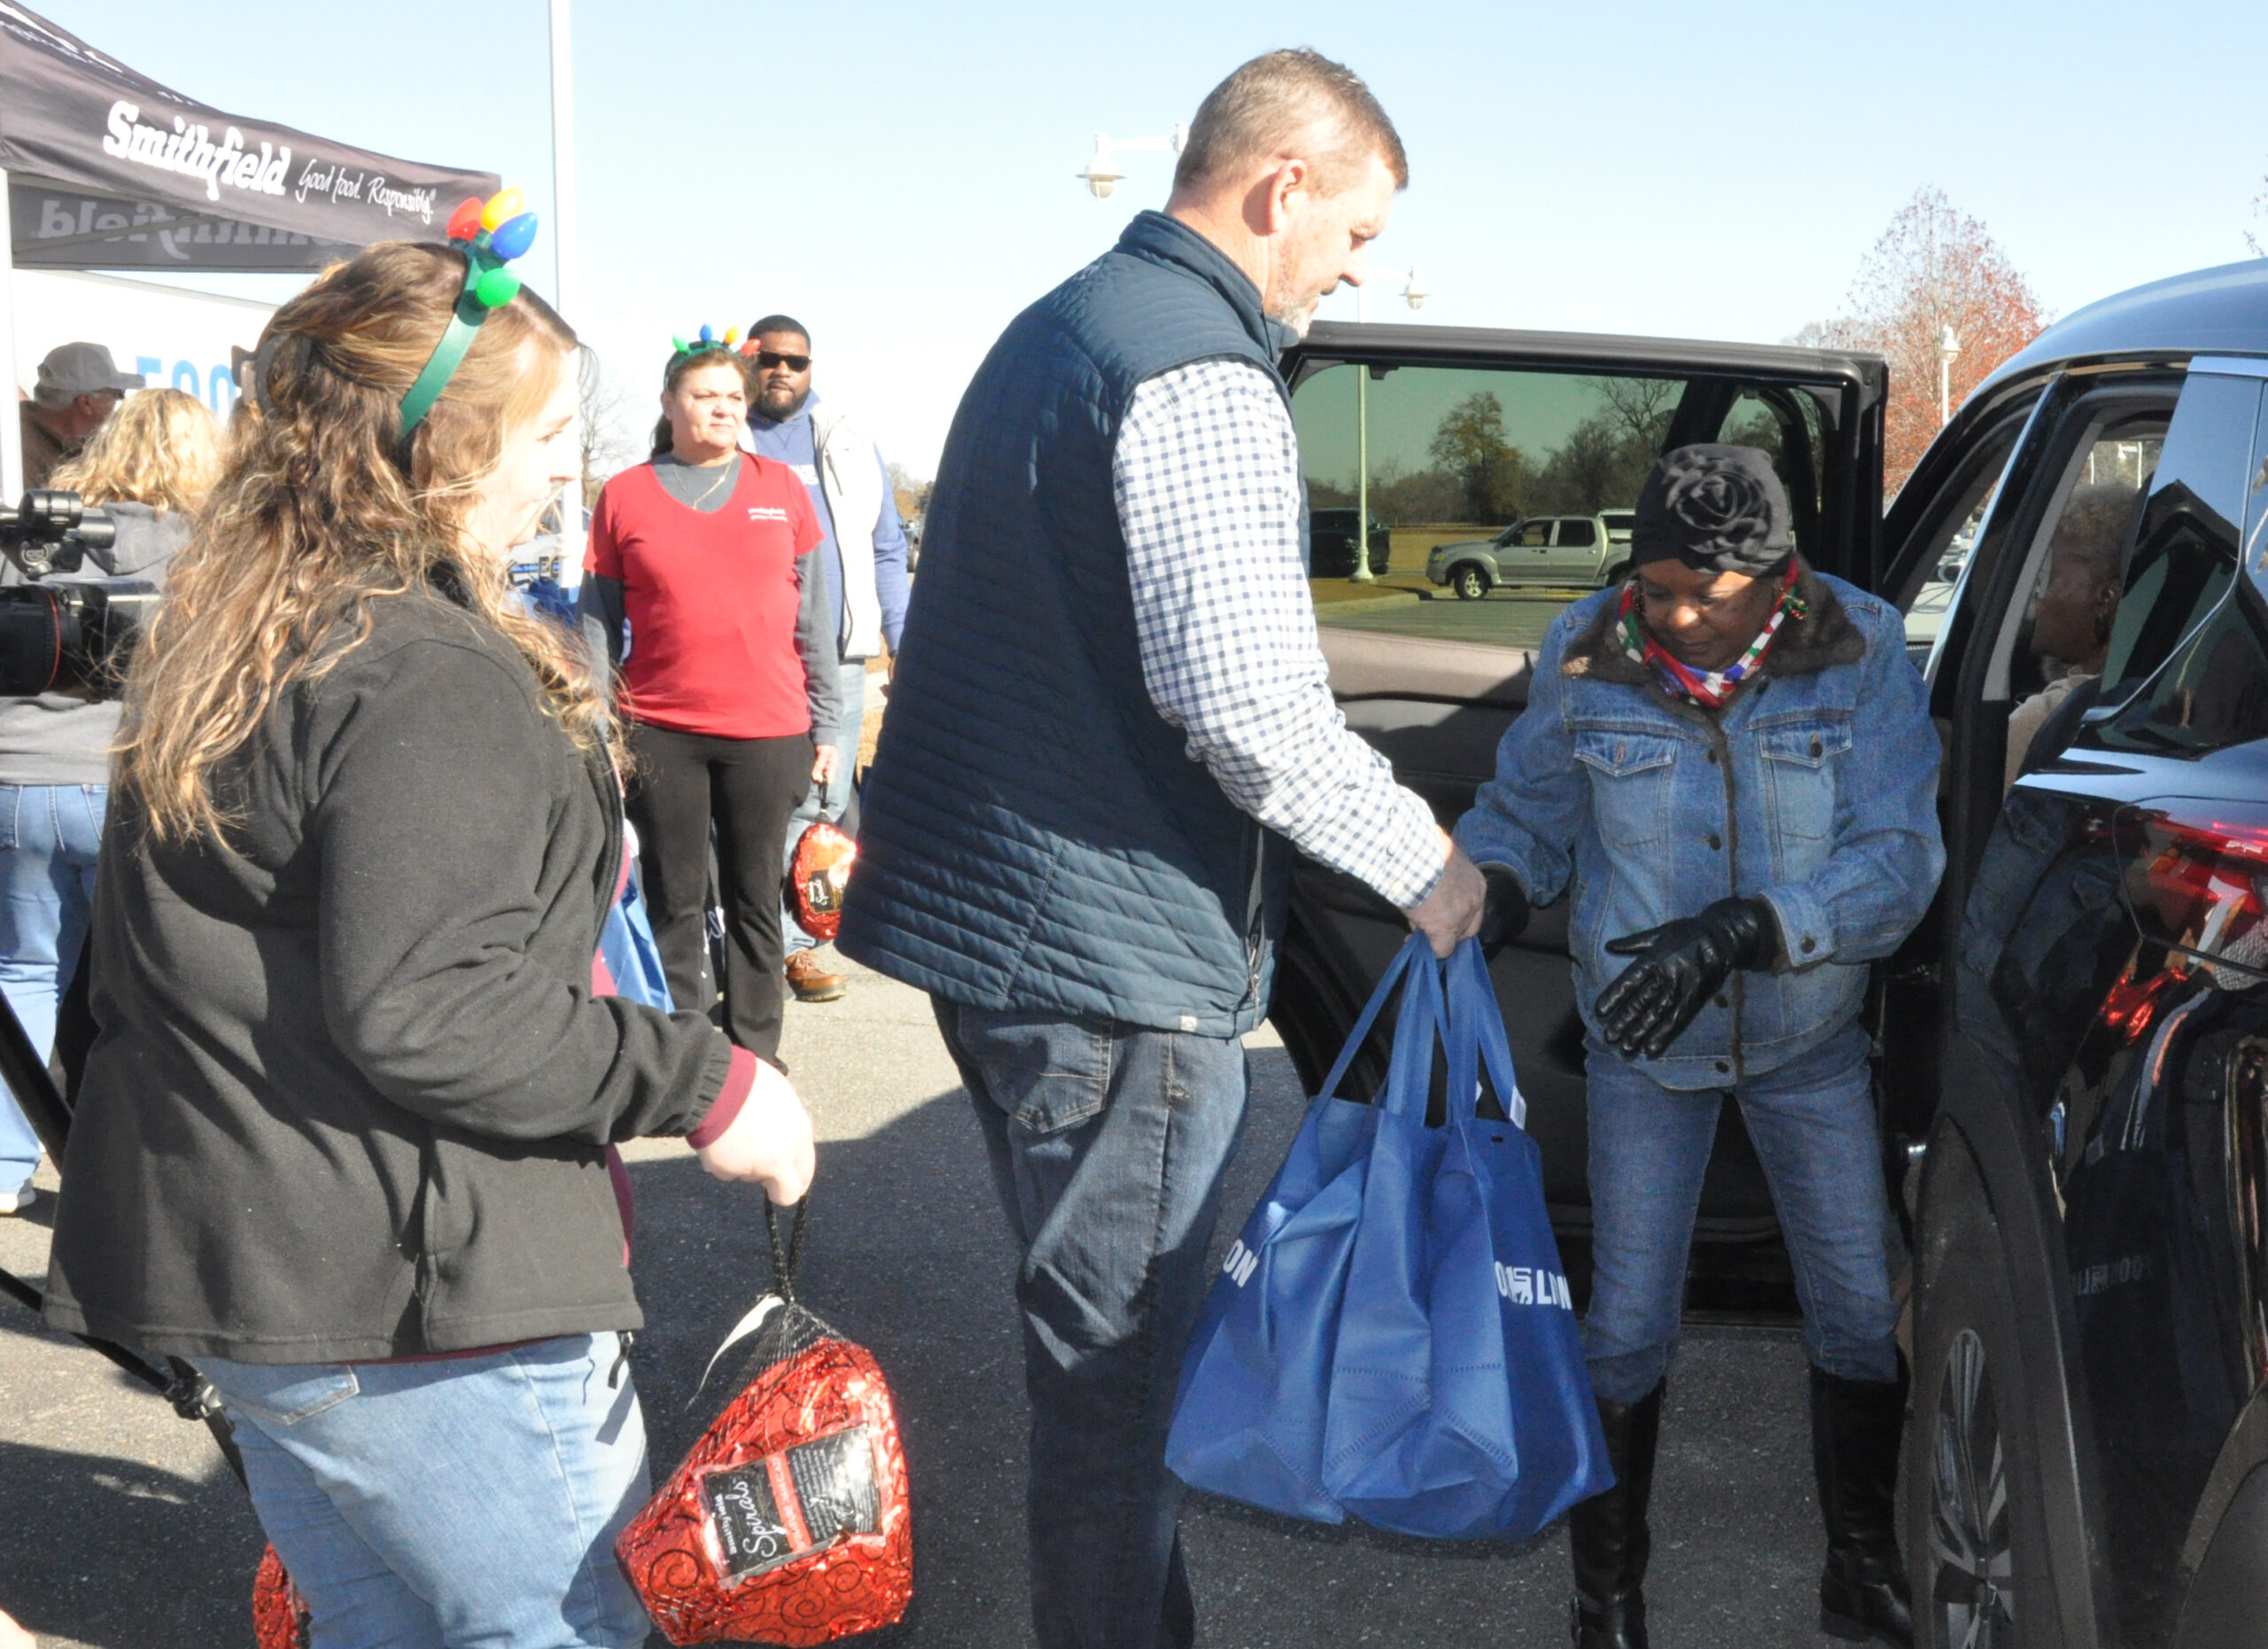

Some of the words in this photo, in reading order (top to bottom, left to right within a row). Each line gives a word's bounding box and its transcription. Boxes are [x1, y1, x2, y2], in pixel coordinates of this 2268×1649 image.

[102, 99, 291, 201] Smithfield
[295, 158, 336, 203] Good
[725, 1481, 779, 1557] Spirals
